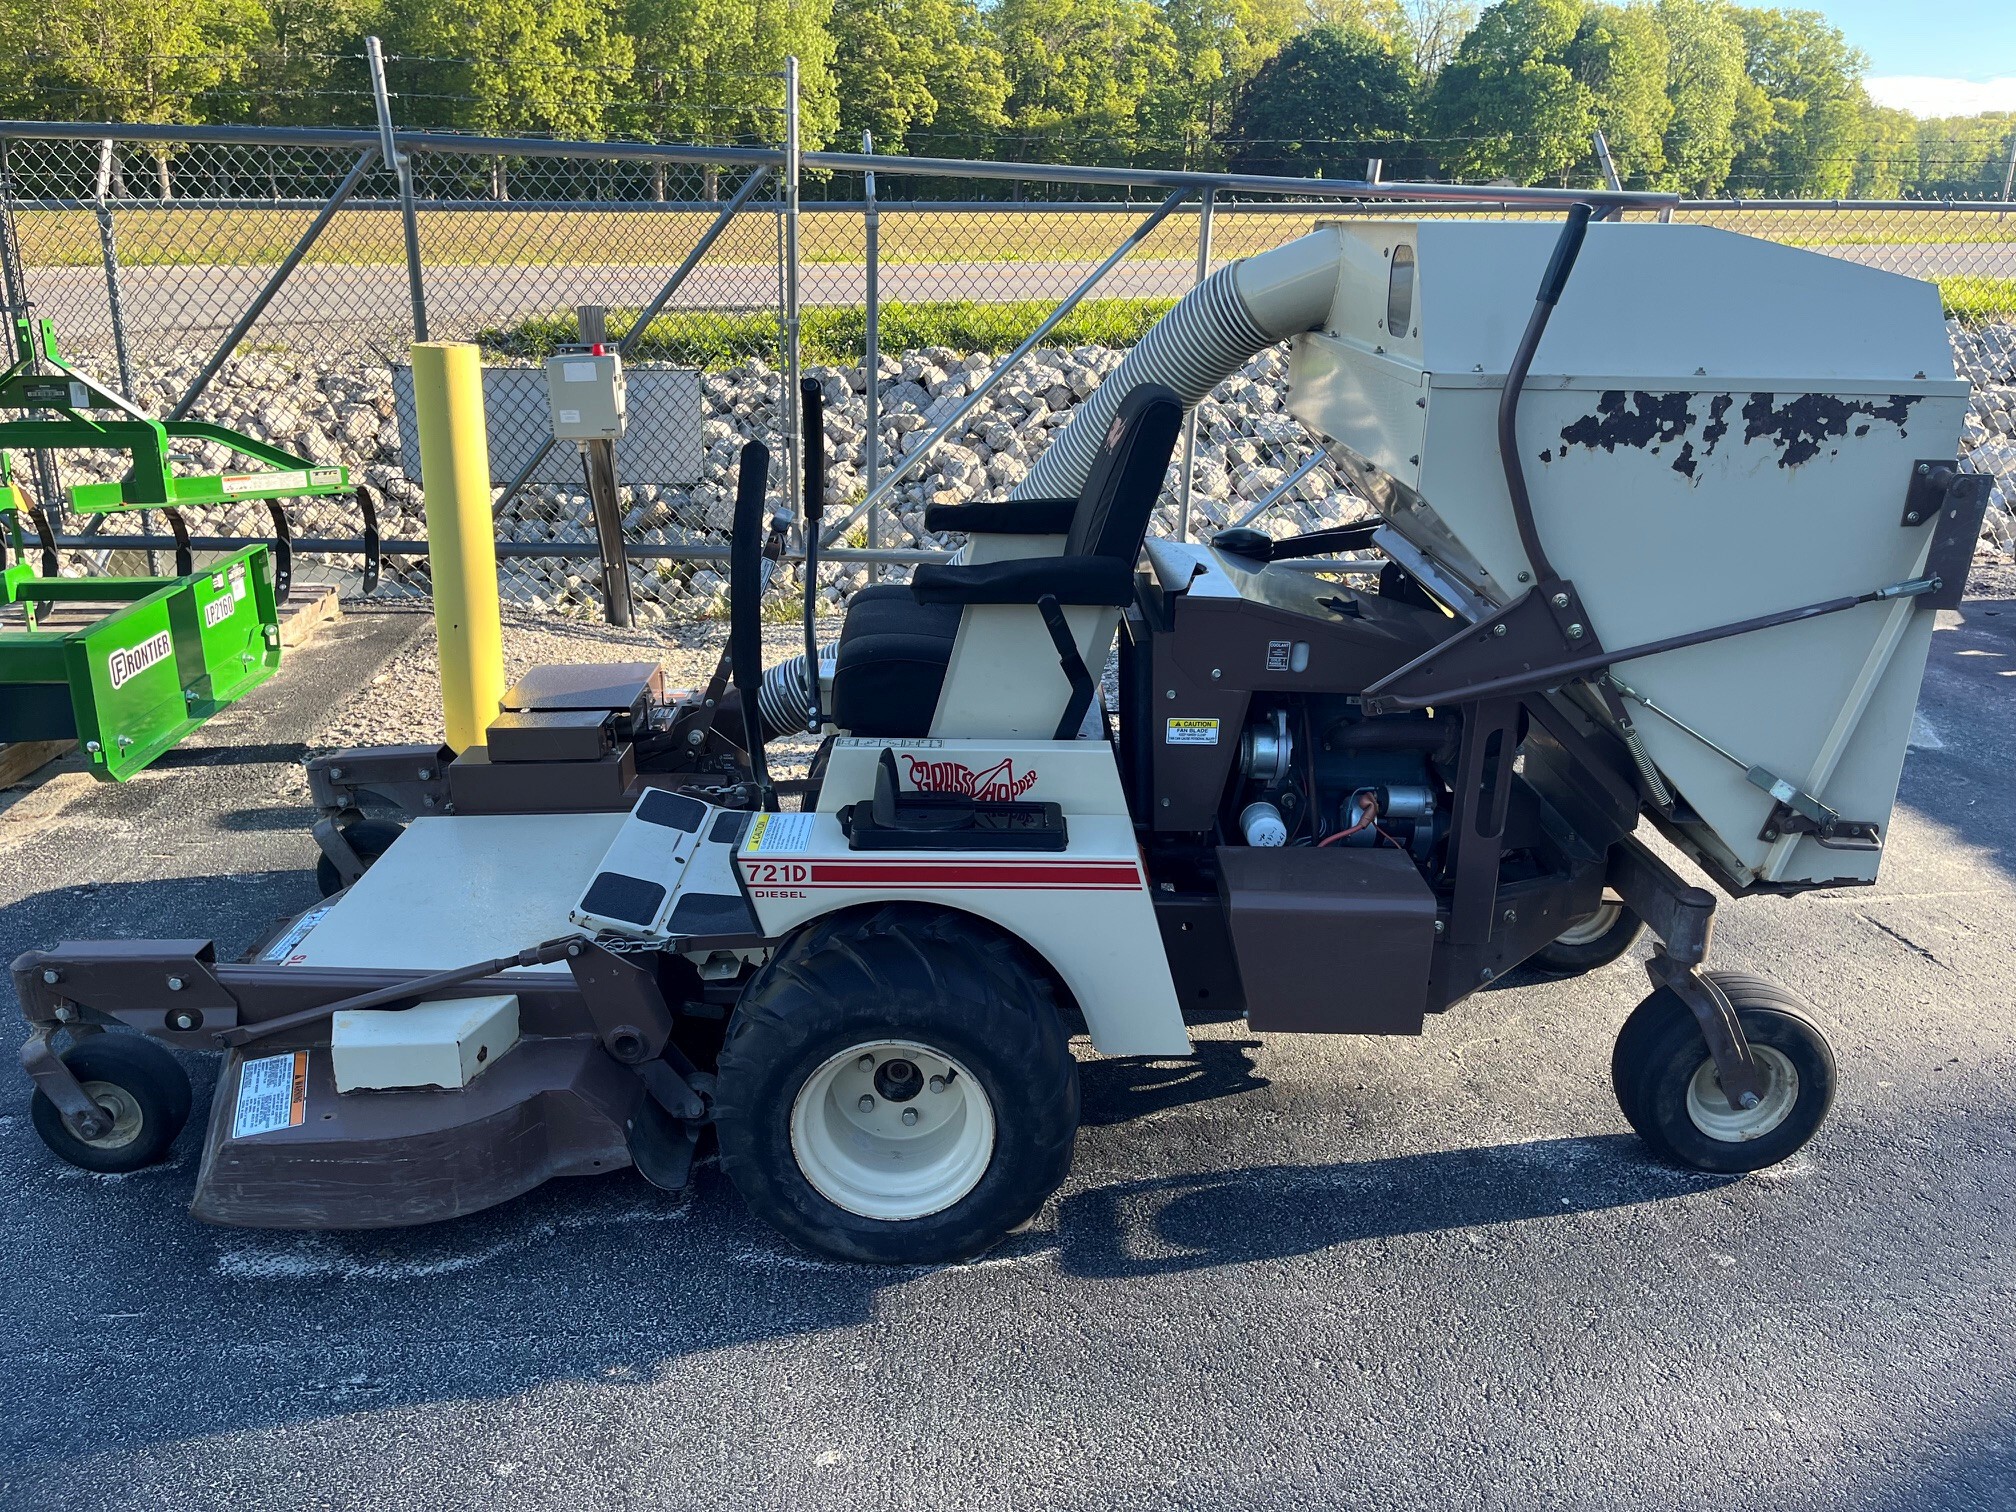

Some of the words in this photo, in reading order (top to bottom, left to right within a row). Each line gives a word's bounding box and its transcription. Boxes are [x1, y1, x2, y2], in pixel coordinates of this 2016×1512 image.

[206, 596, 234, 626] LP2160
[110, 633, 170, 686] FRONTIER
[752, 821, 766, 840] CAUTION
[746, 864, 807, 882] 721D
[755, 890, 807, 899] DIESEL
